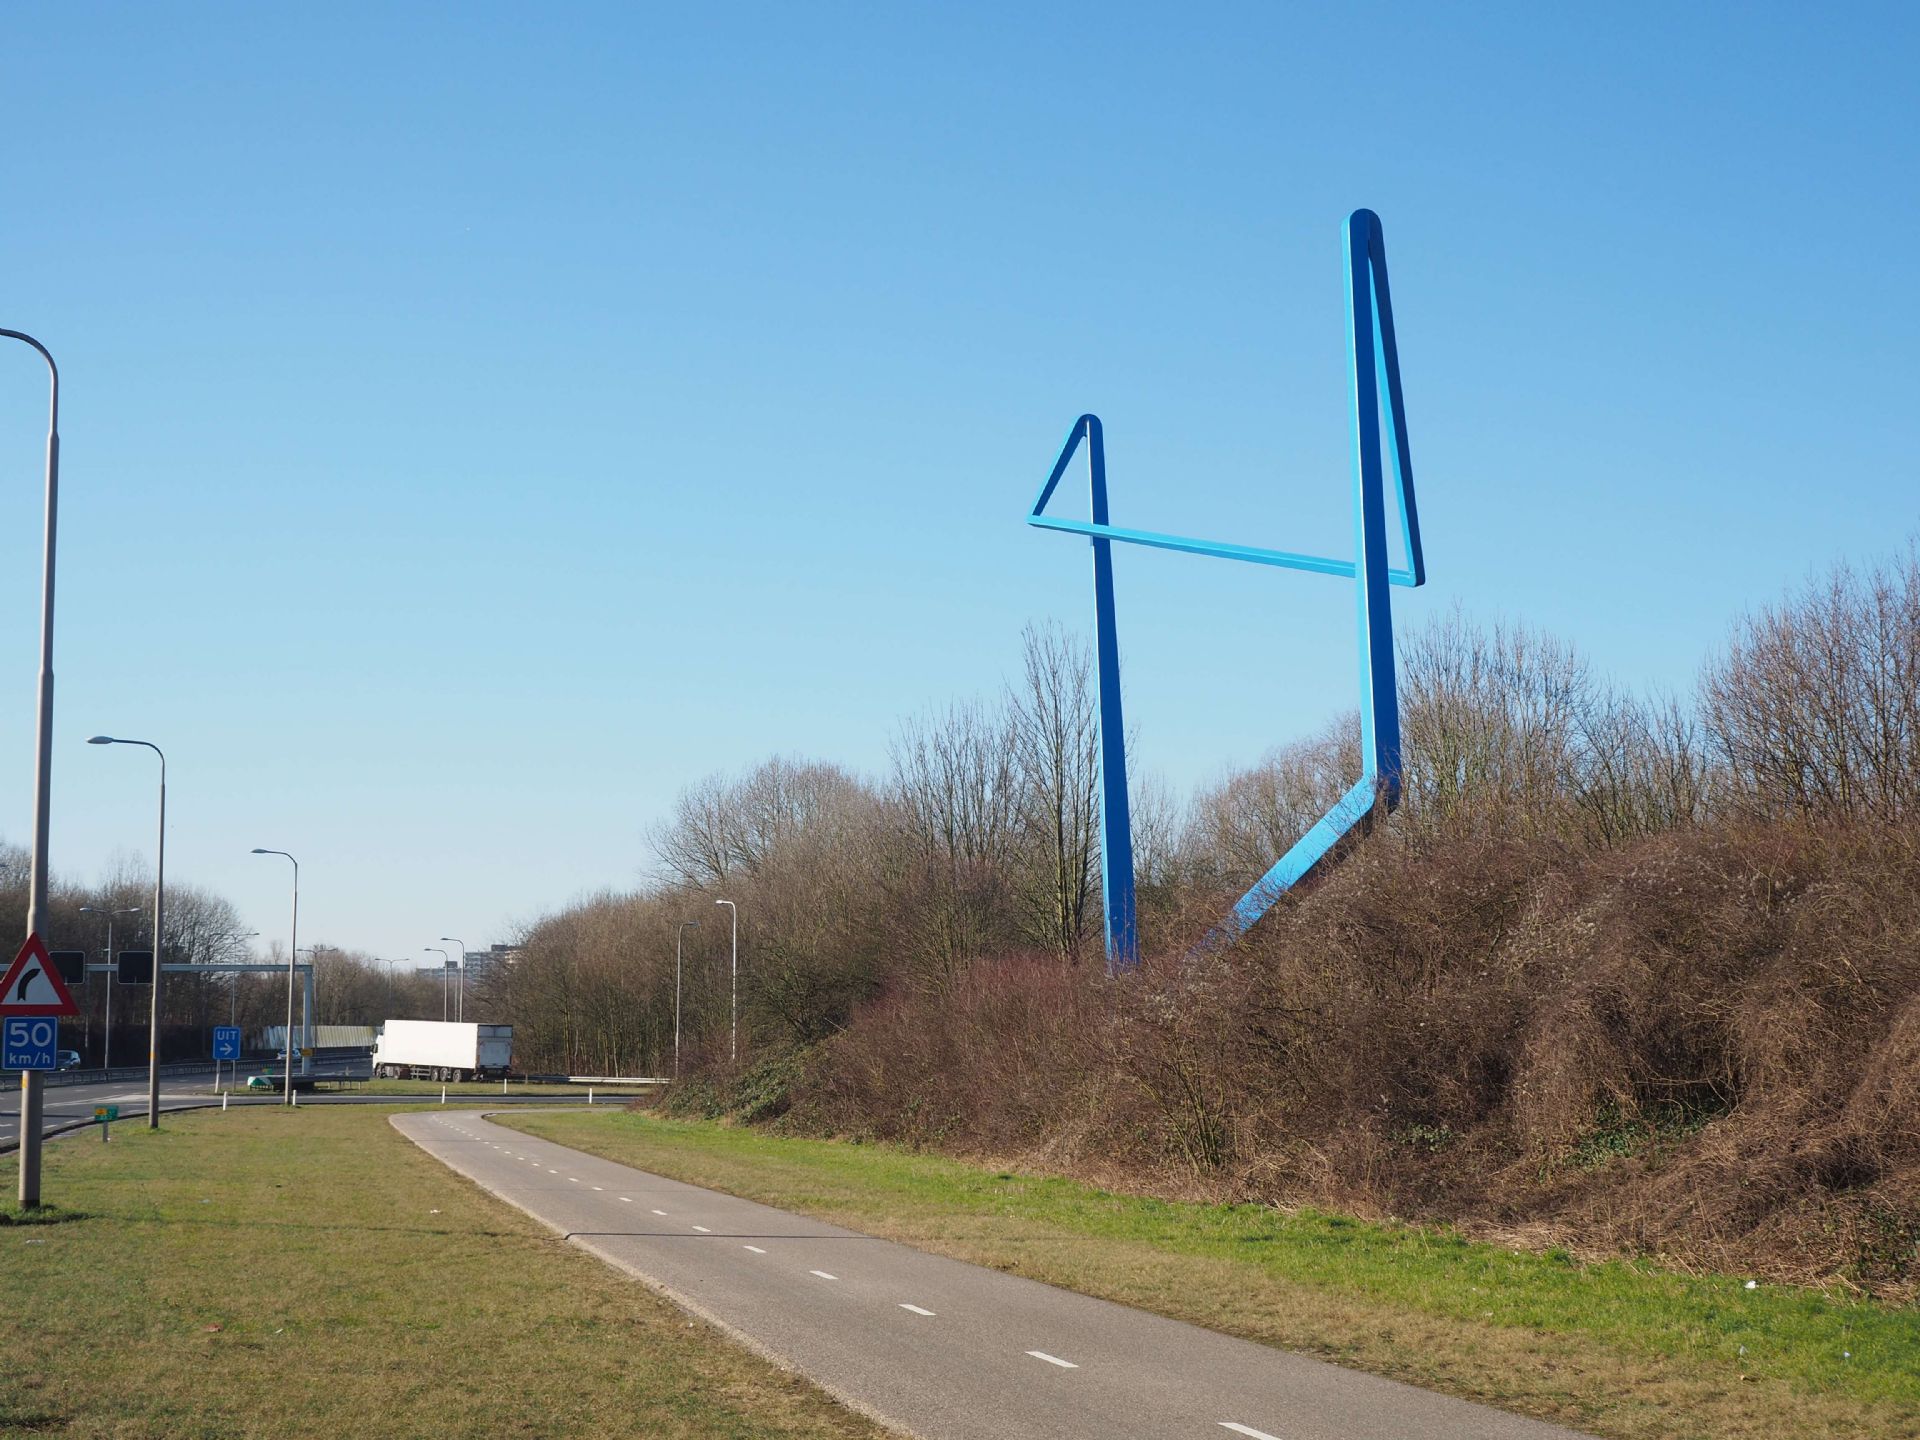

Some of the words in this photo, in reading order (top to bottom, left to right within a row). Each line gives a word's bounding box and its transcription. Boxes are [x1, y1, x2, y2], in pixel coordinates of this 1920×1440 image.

[9, 1022, 52, 1047] 50
[216, 1030, 238, 1040] UIT
[9, 1052, 51, 1066] km/h
